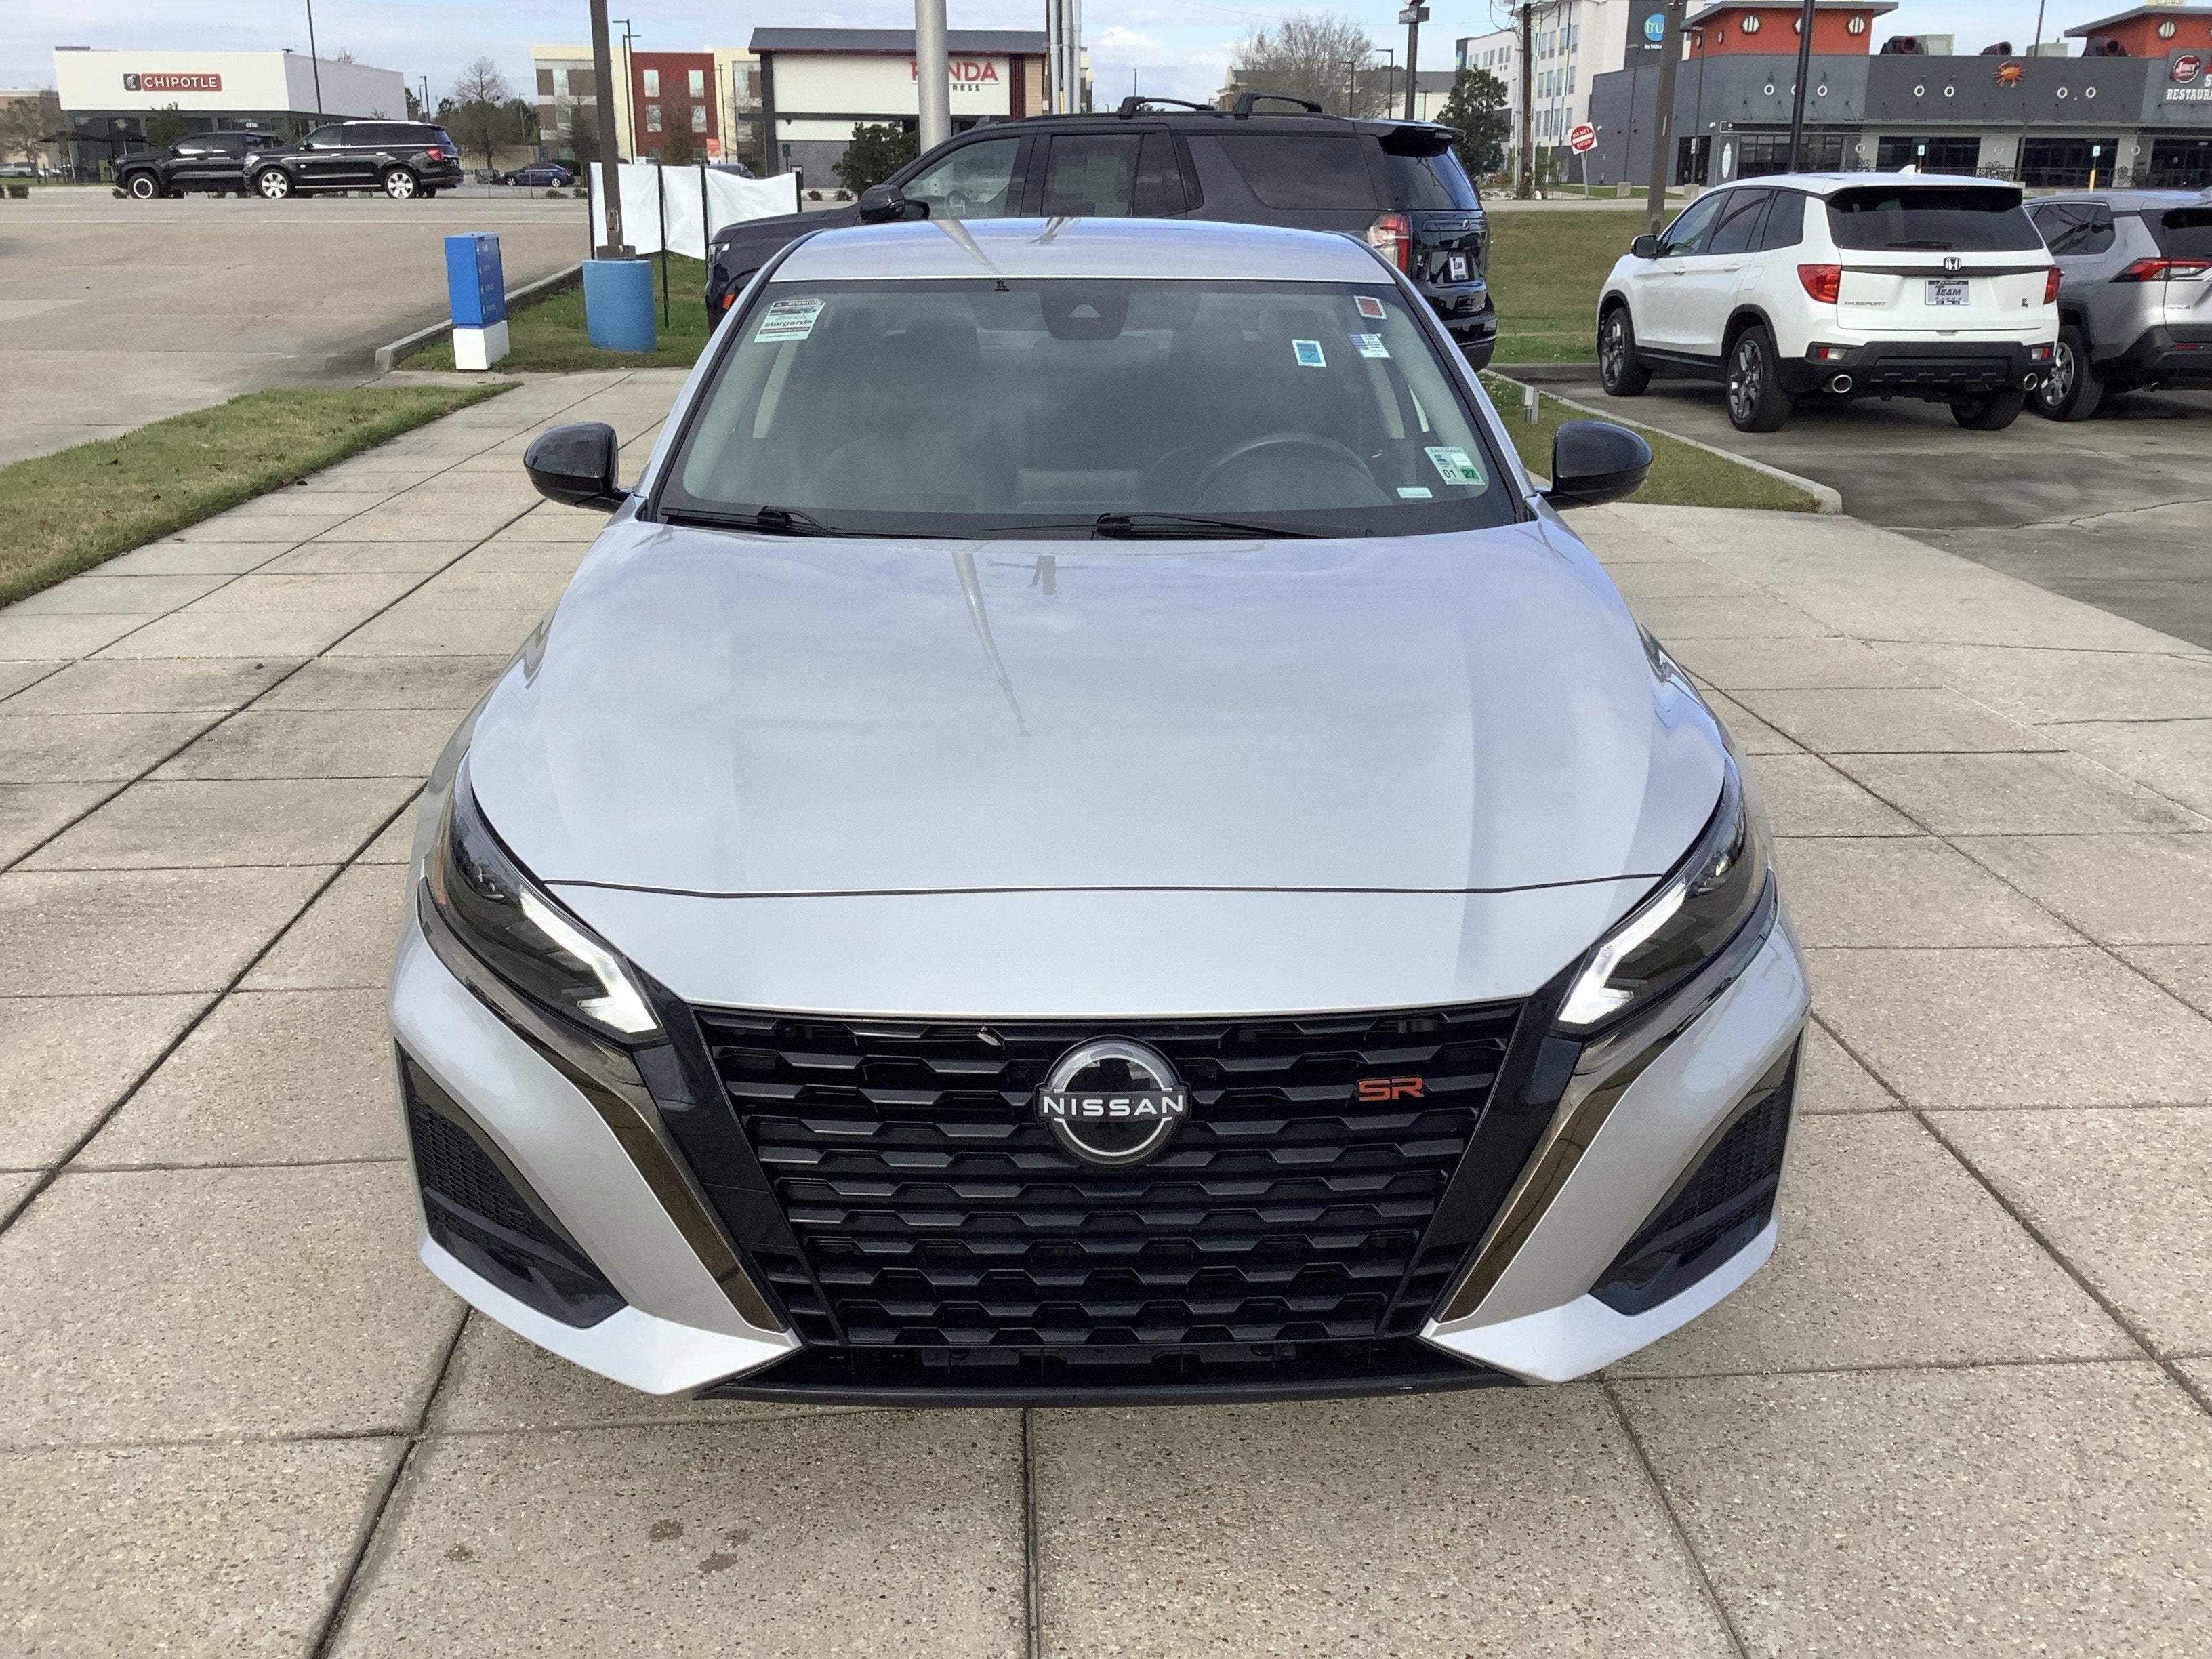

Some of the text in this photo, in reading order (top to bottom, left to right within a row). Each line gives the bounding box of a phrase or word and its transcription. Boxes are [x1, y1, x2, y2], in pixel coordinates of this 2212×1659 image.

[1645, 19, 1664, 33] tru
[910, 61, 998, 81] NDA
[144, 77, 218, 87] CHIPOTLE
[1577, 139, 1591, 148] ENTER
[1935, 285, 1962, 296] TEAM
[1443, 469, 1457, 478] 01
[1358, 1076, 1425, 1102] SR
[1043, 1094, 1183, 1118] NISSAN
